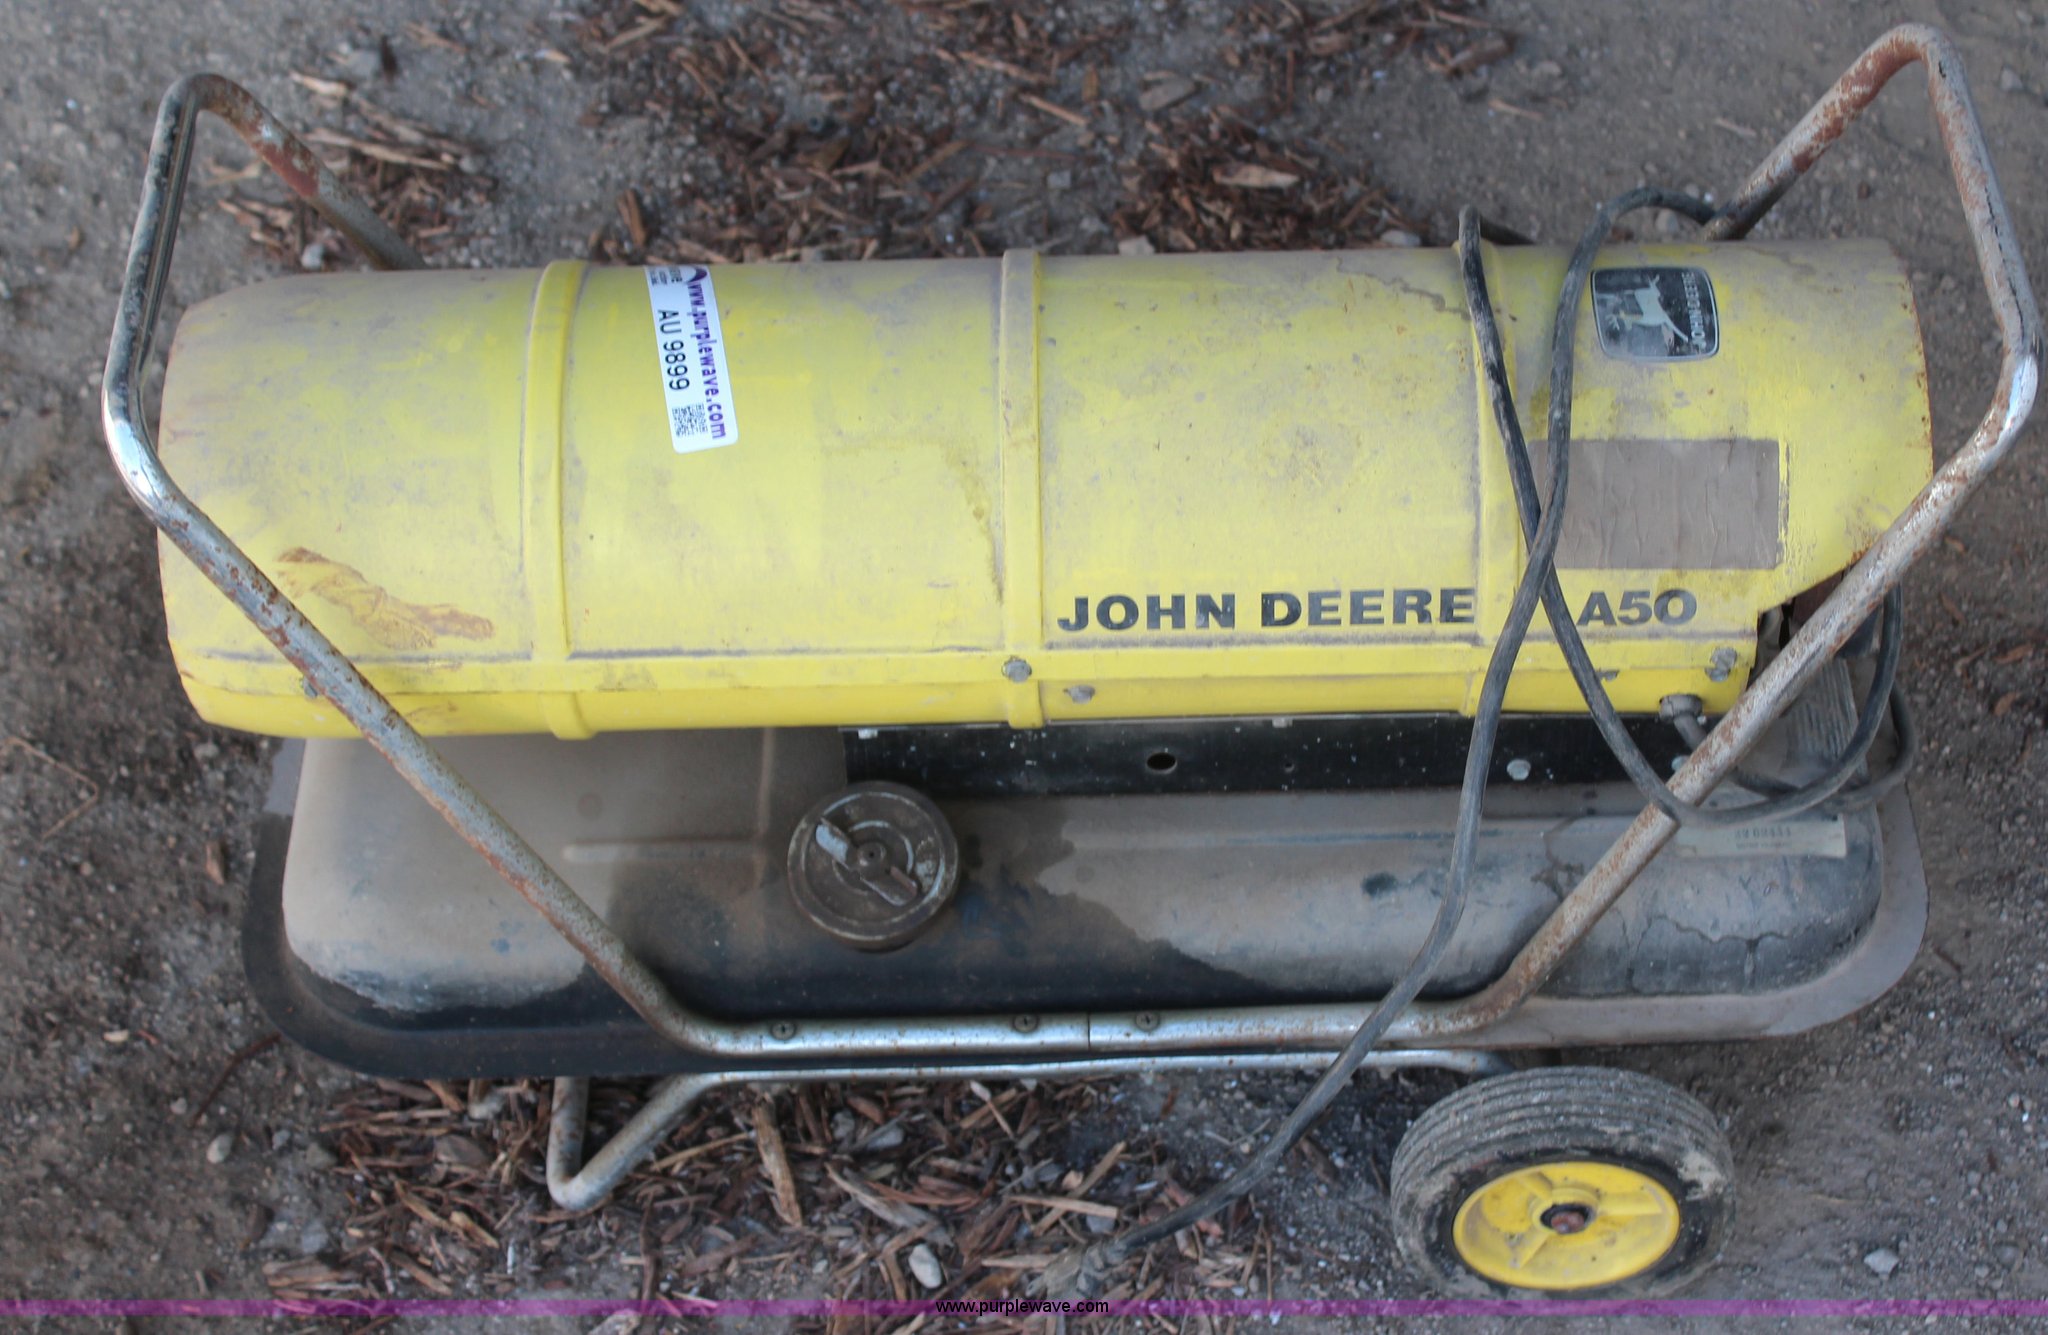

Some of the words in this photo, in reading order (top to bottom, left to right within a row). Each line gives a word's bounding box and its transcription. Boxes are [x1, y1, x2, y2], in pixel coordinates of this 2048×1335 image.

[657, 308, 683, 335] AU
[663, 339, 690, 392] 9899
[687, 281, 726, 440] www.purplewave.com
[1056, 593, 1235, 632] JOHN
[1261, 587, 1475, 627] DEERE
